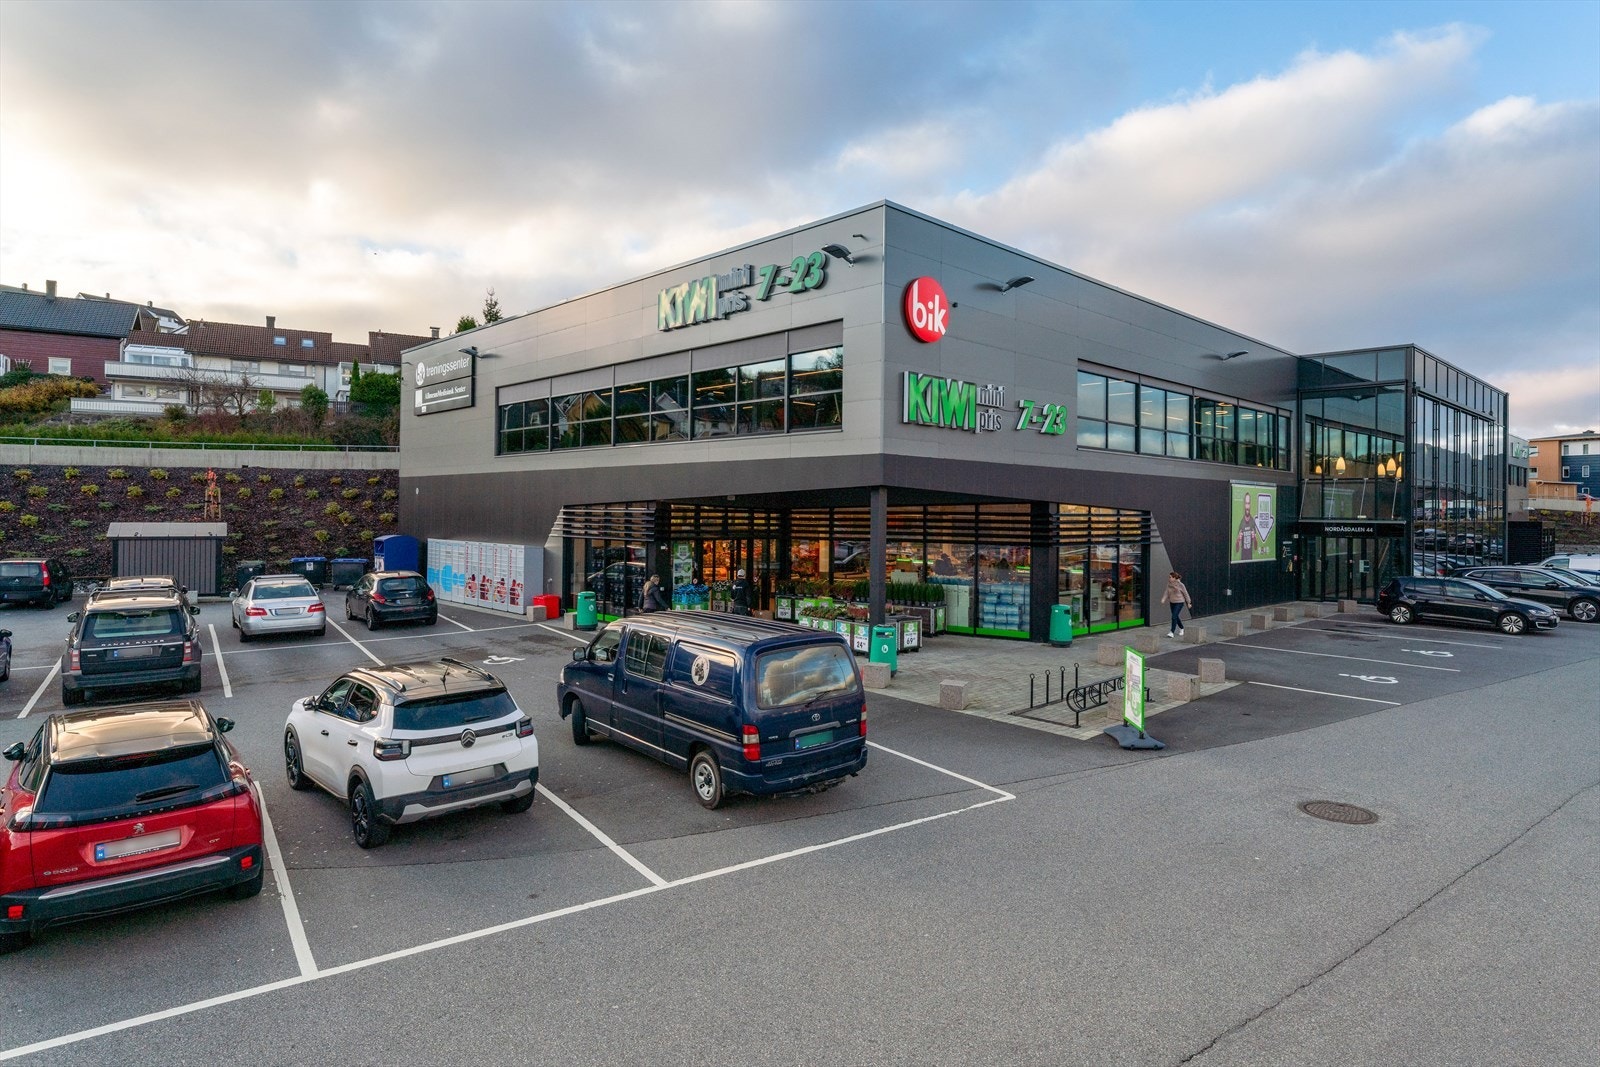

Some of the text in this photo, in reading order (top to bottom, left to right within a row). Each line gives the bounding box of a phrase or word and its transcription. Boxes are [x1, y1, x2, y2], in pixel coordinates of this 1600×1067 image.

[658, 274, 719, 331] KIWI
[912, 280, 947, 335] bik
[425, 356, 470, 377] treningssenter
[903, 371, 977, 431] KIWI
[978, 384, 1005, 407] mini
[977, 409, 1002, 434] pris
[1016, 399, 1068, 435] 7-23
[1324, 525, 1365, 533] NORDÅSDALEN
